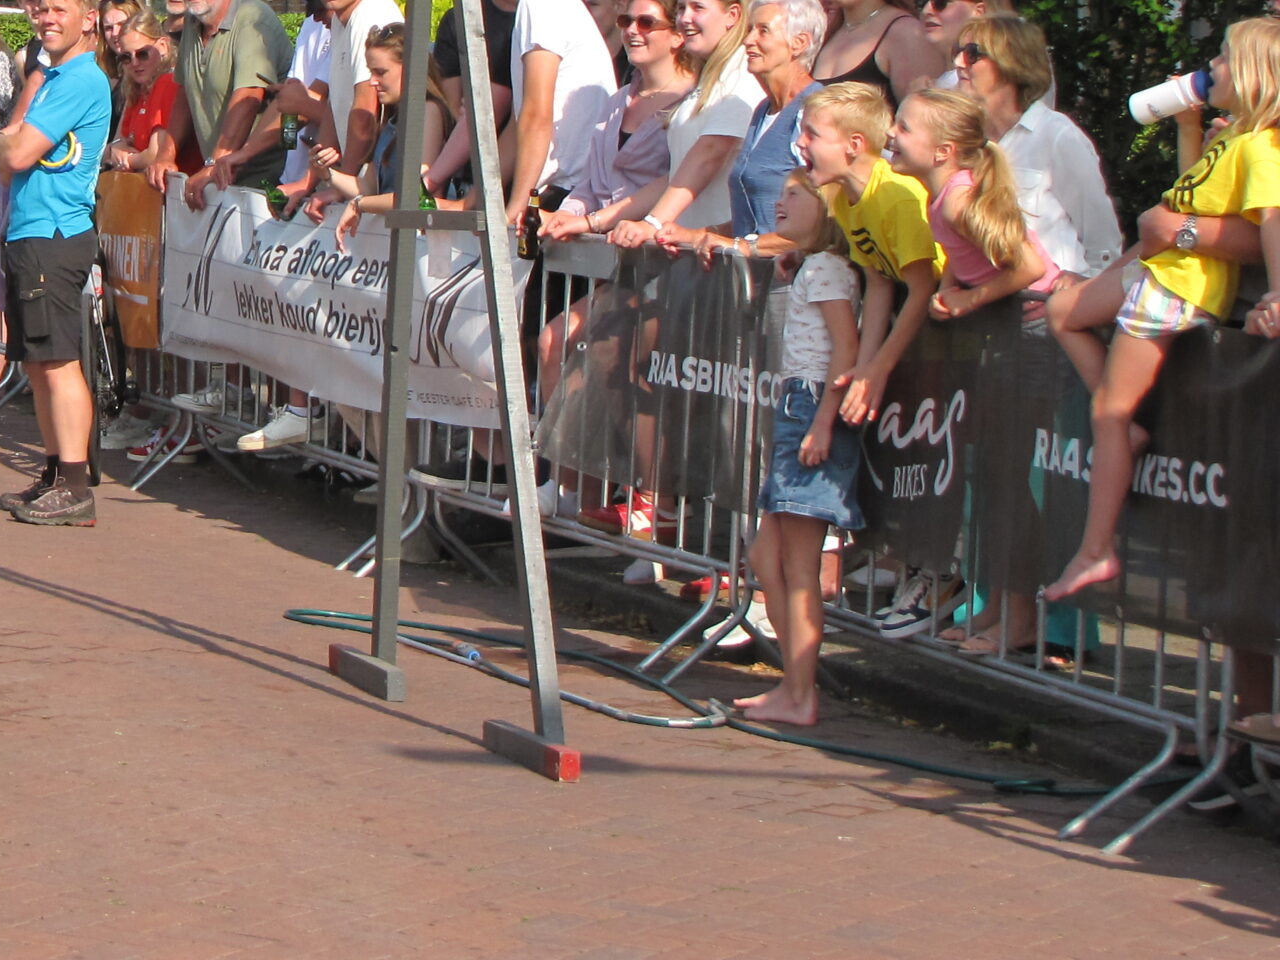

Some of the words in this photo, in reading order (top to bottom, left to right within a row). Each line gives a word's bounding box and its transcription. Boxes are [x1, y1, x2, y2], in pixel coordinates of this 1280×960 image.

[287, 240, 353, 290] afloop
[233, 281, 275, 326] lekker
[274, 290, 322, 335] koud
[647, 350, 783, 409] RAASBIKESCC
[892, 463, 928, 501] BIKES
[1033, 427, 1227, 508] RAASIKES.CC
